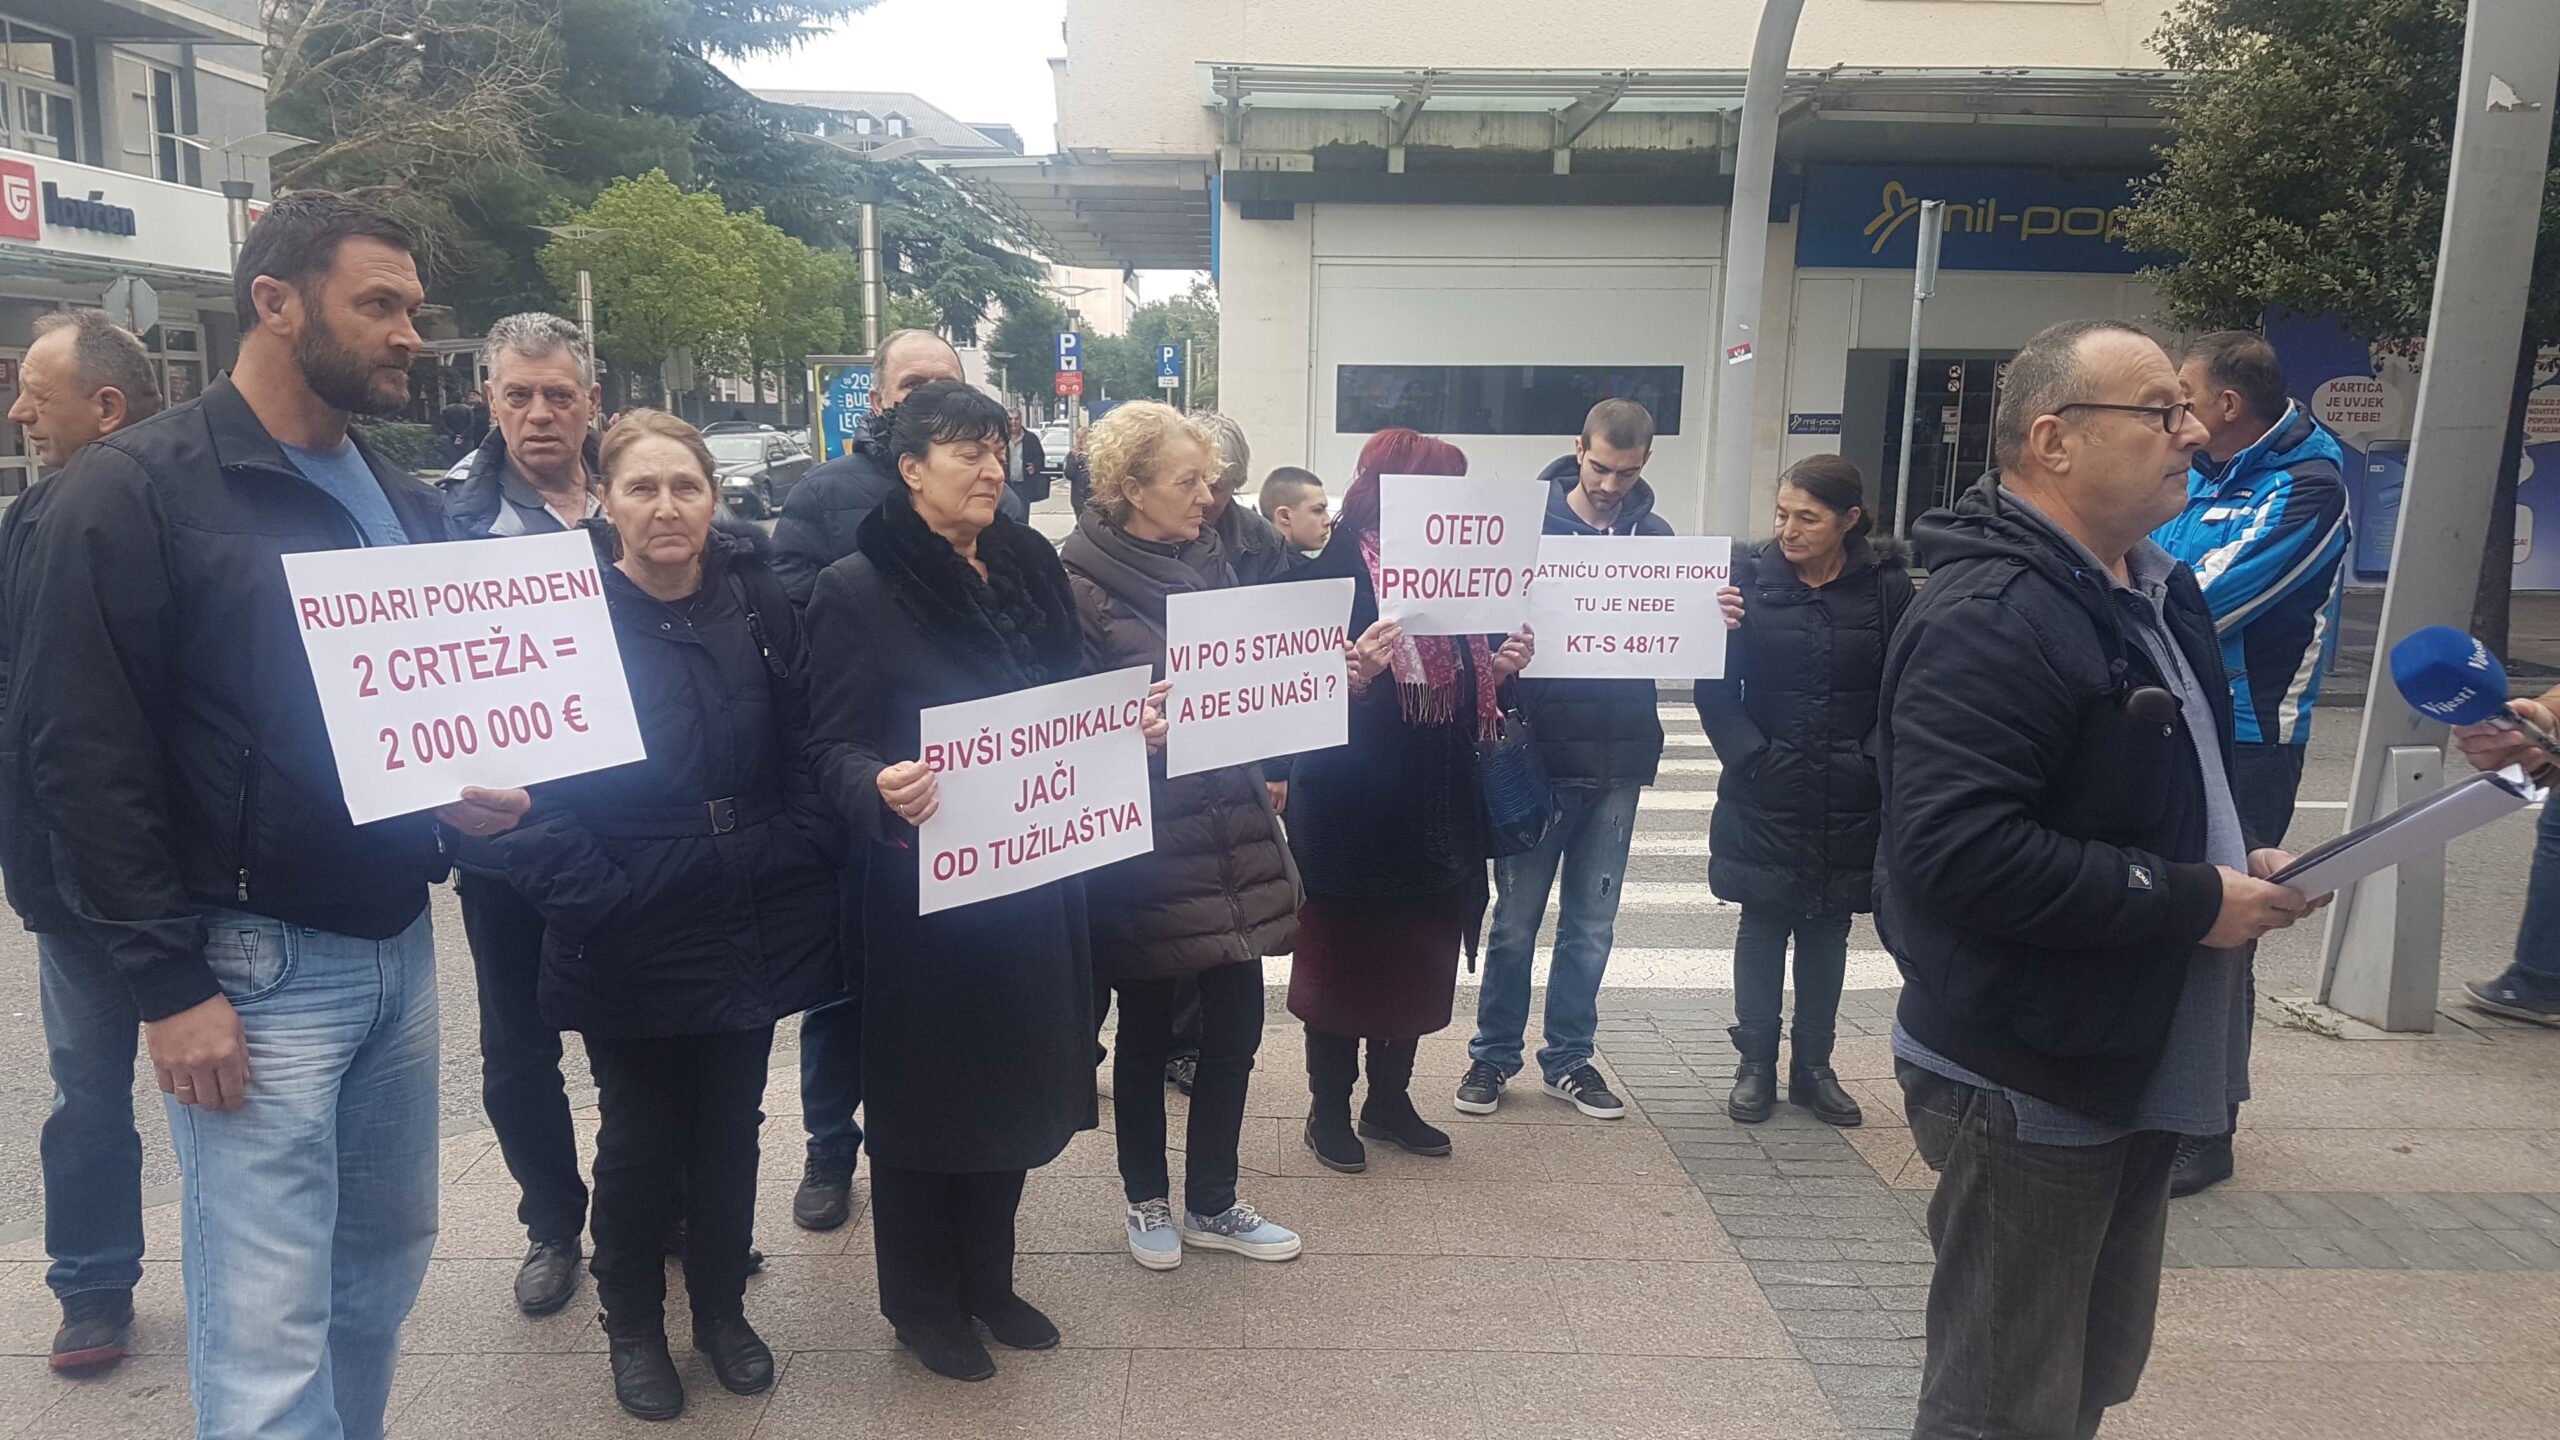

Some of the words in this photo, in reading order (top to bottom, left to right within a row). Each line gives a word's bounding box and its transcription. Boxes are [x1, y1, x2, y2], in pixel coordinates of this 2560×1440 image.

[42, 182, 136, 237] lovćen
[1060, 333, 1076, 354] P
[1163, 347, 1173, 362] P
[845, 392, 869, 408] BUD
[2326, 397, 2341, 407] JE
[2344, 397, 2384, 408] UVJEK
[2330, 382, 2383, 393] KARTICA
[2327, 411, 2343, 422] UZ
[2346, 412, 2381, 422] TEBE!
[1426, 513, 1504, 545] OTETO
[1382, 567, 1512, 599] PROKLETO
[1521, 568, 1534, 596] ?
[1534, 561, 1599, 579] ATNIĆU
[1604, 565, 1671, 579] OTVORI
[1676, 565, 1728, 580] FIOKU
[300, 588, 418, 630] RUDARI
[424, 568, 600, 616] POKRADENI
[1575, 598, 1596, 612] TU
[1601, 598, 1622, 612] JE
[1628, 598, 1675, 612] NEĐE
[1170, 645, 1190, 672] VI
[1198, 641, 1228, 669] PO
[1235, 639, 1246, 664] 5
[1252, 626, 1345, 661] STANOVA
[1567, 635, 1617, 653] KT-S
[1623, 635, 1680, 653] 48/17
[353, 655, 378, 698] 2
[388, 626, 548, 692] CRTEŽA
[1179, 697, 1196, 723] A
[1201, 691, 1231, 719] ĐE
[1238, 685, 1264, 713] SU
[1271, 672, 1318, 708] NAŠI
[1325, 675, 1337, 698] ?
[2420, 687, 2477, 715] Vijesti
[379, 728, 405, 771] 2
[412, 715, 477, 764] 000
[487, 701, 553, 748] 000
[562, 694, 589, 732] €
[925, 726, 1002, 773] BIVŠI
[1010, 698, 1146, 758] SINDIKALCI
[1014, 760, 1075, 812] JAČI
[933, 847, 978, 881] OD
[988, 801, 1142, 869] TUŽILAŠTVA
